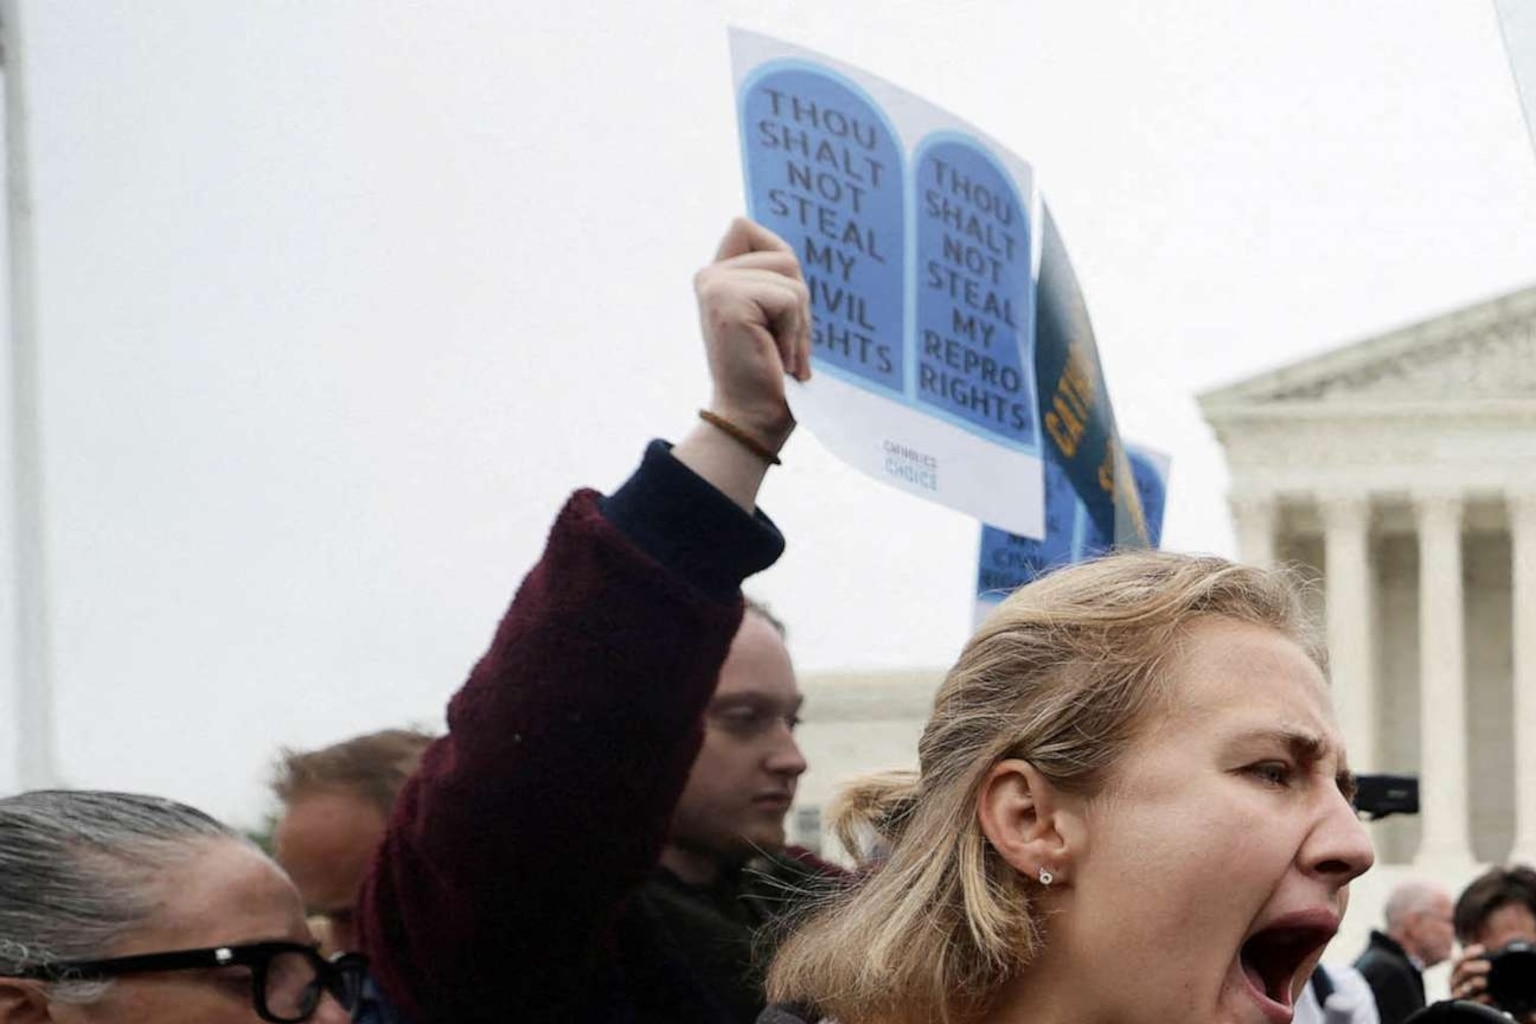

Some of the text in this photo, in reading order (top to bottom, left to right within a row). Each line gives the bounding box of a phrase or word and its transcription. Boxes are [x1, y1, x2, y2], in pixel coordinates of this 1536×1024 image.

[764, 88, 877, 150] THOU
[759, 119, 885, 189] SHALT
[787, 160, 867, 213] NOT
[932, 158, 1013, 227] THOU
[768, 189, 886, 264] STEAL
[925, 188, 1016, 260] SHALT
[804, 236, 856, 282] MY
[942, 233, 1002, 285] NOT
[808, 274, 875, 331] IVIL
[927, 260, 1018, 331] STEAL
[811, 313, 893, 375] GHTS
[952, 306, 996, 348] MY
[923, 328, 1021, 394] REPRO
[919, 362, 1026, 431] RIGHTS
[885, 457, 938, 491] CHOICE
